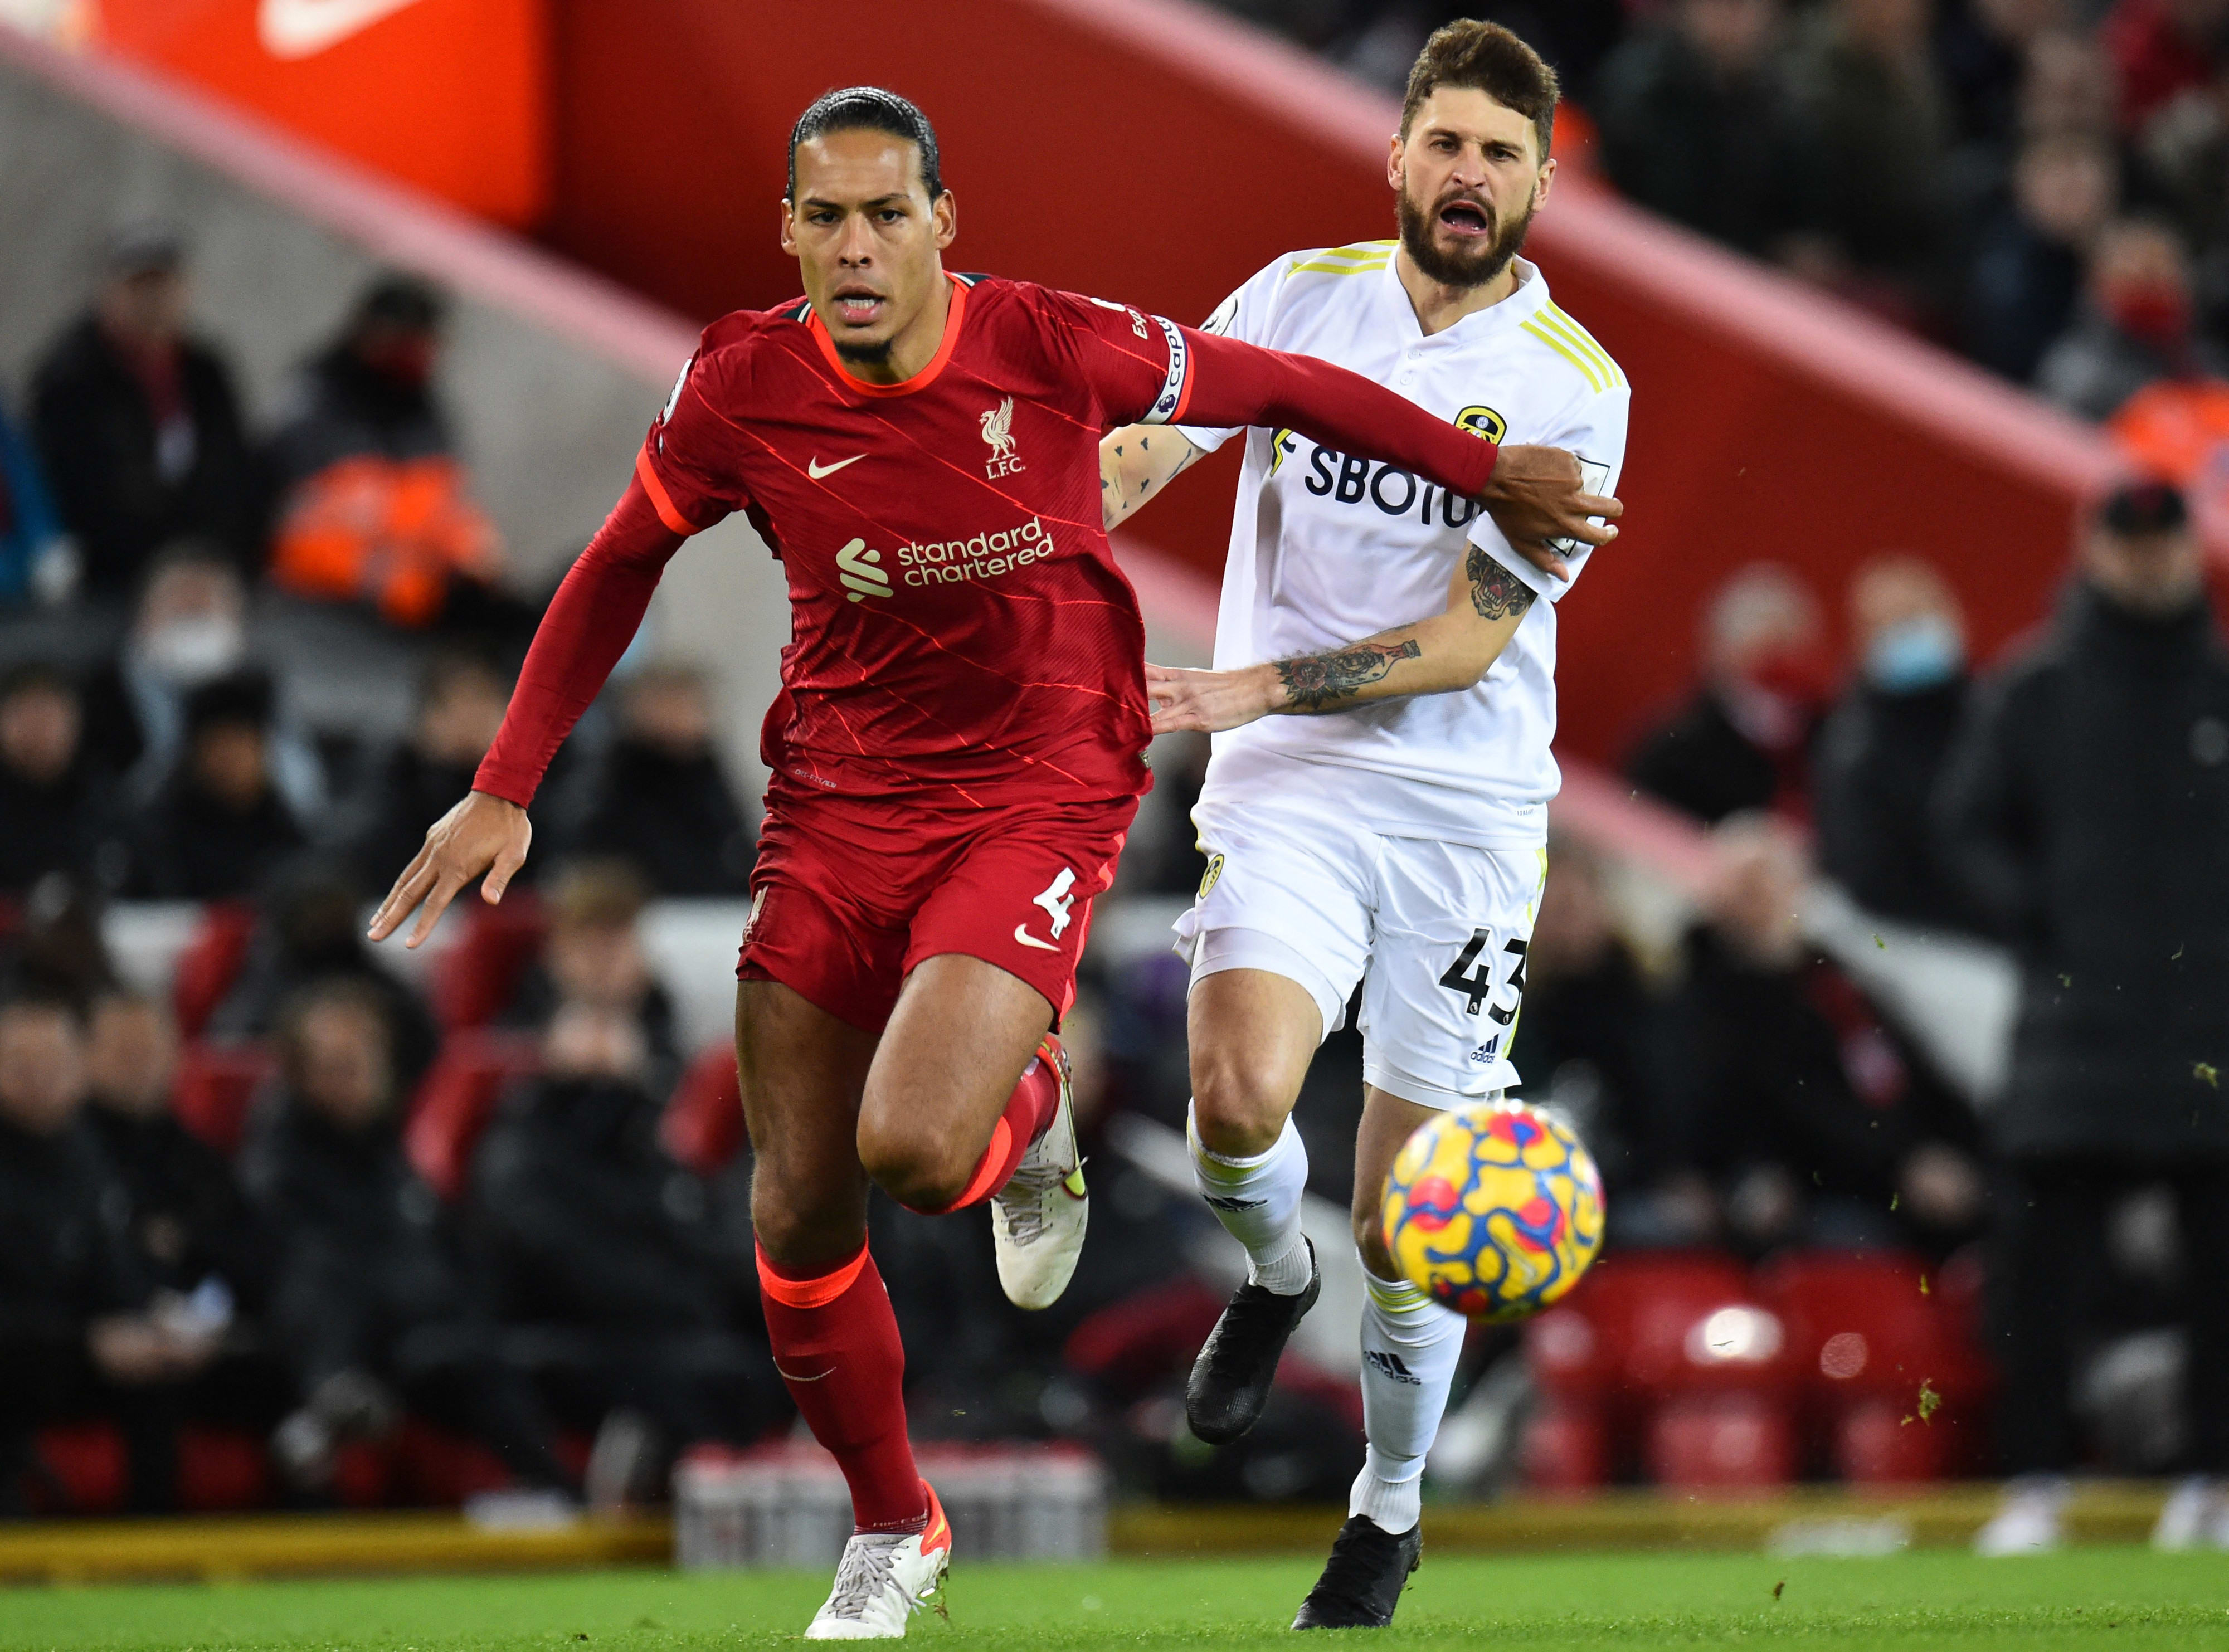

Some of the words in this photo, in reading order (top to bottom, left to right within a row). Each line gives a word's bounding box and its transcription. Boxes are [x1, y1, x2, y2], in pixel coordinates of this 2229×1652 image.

[1127, 308, 1148, 340] Exp
[1305, 446, 1477, 528] SBOTO
[897, 515, 1042, 566] standard
[904, 533, 1054, 586] chartered
[1033, 866, 1076, 941] 4
[1439, 928, 1528, 1026] 43
